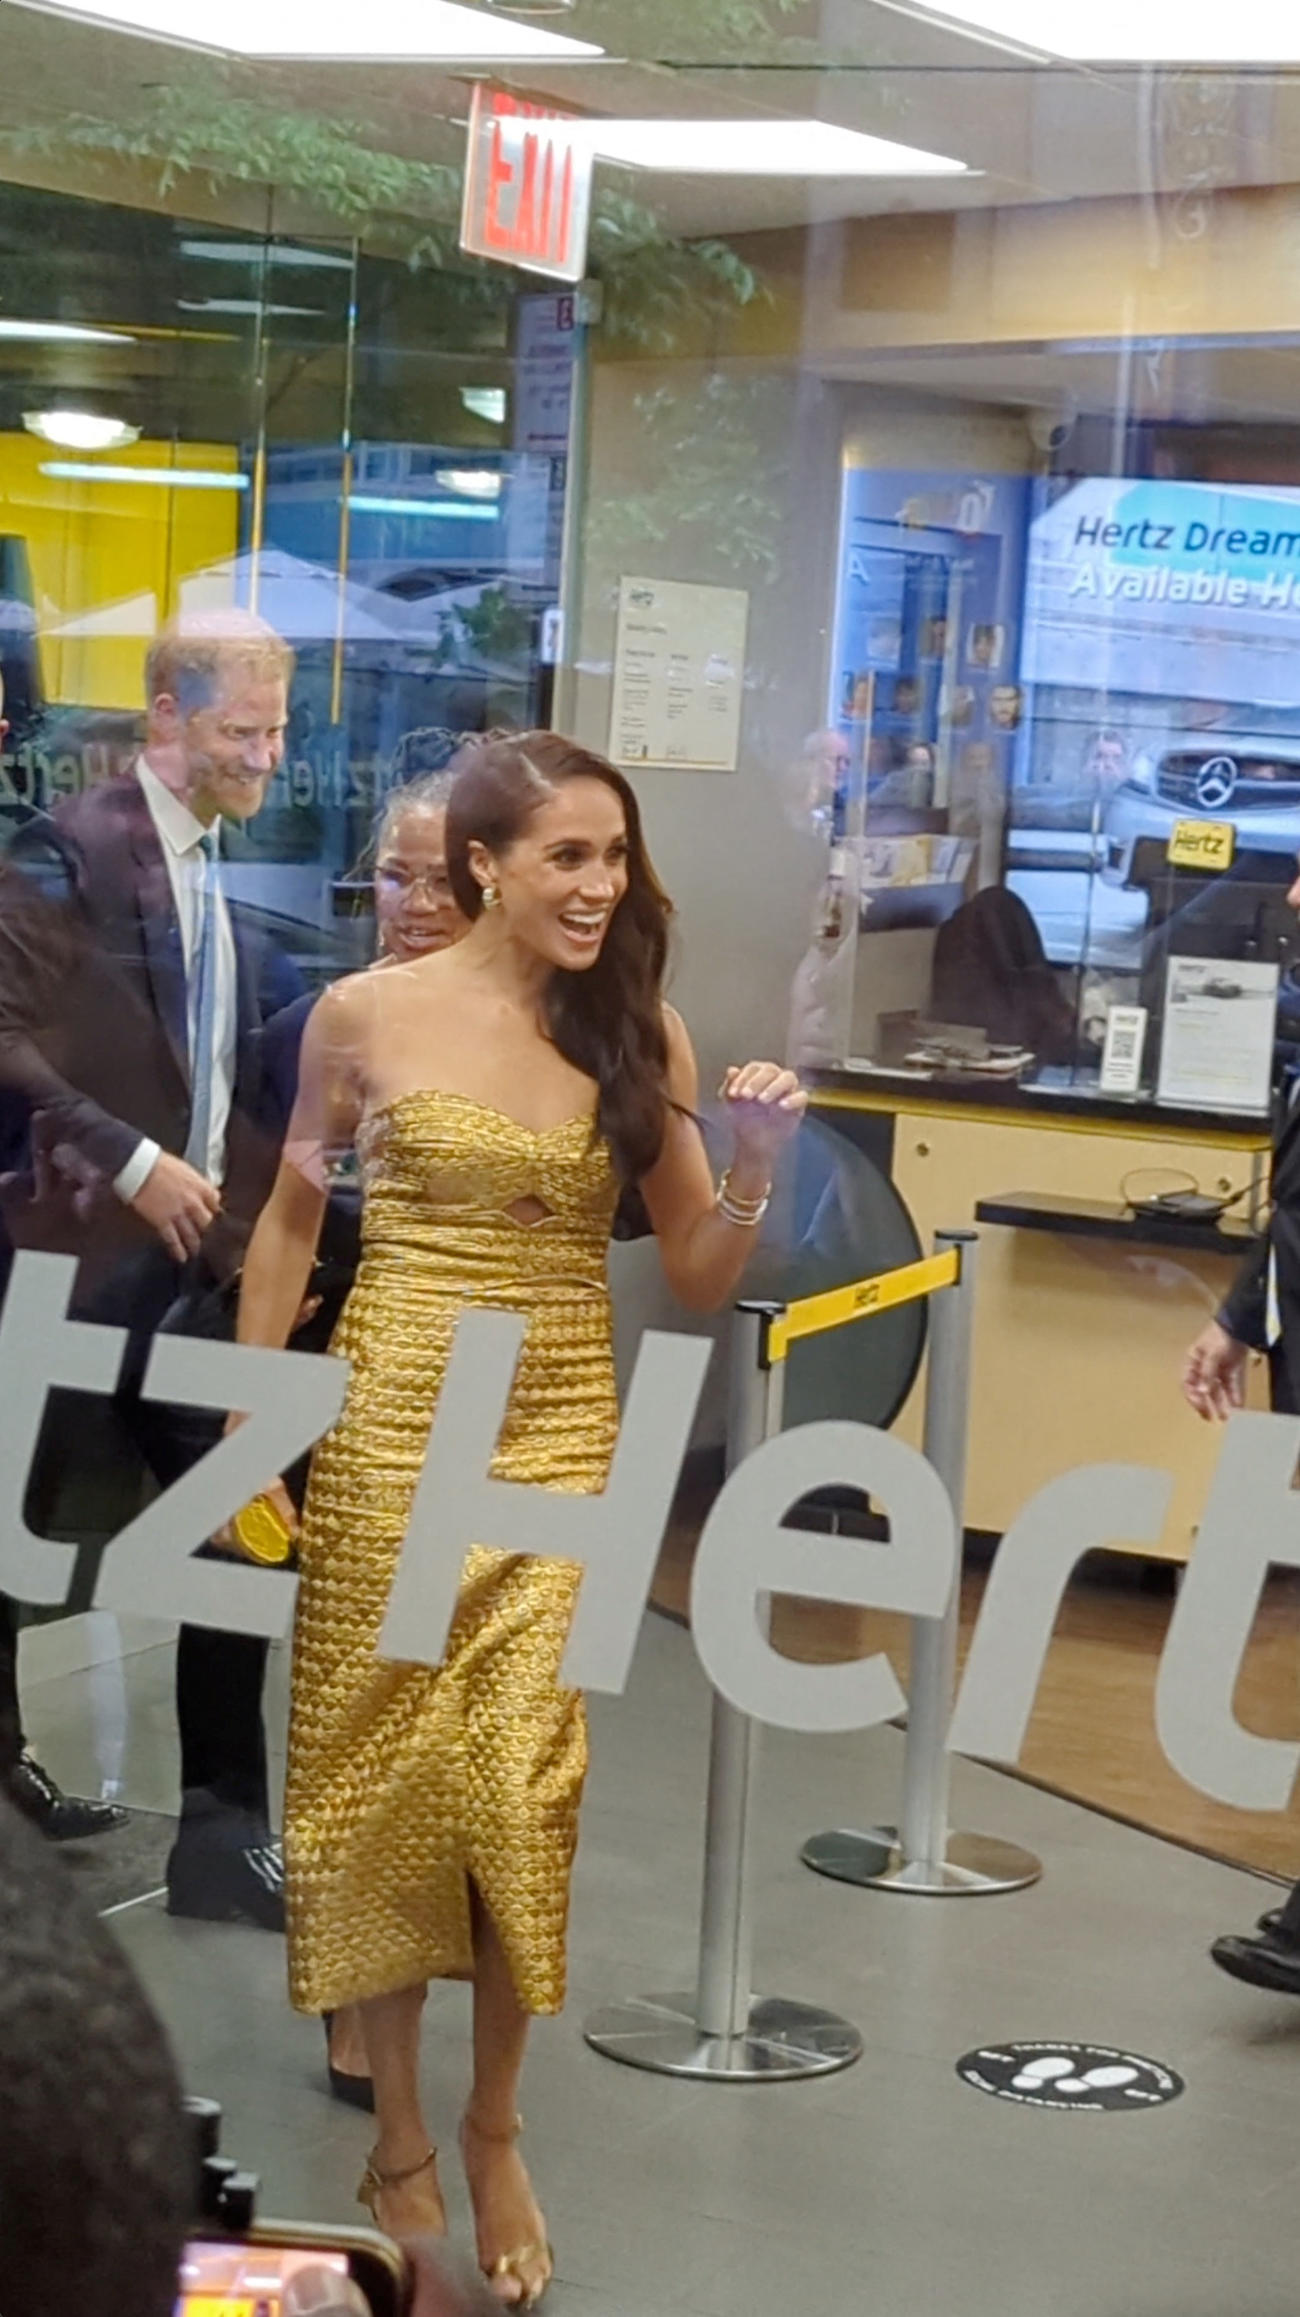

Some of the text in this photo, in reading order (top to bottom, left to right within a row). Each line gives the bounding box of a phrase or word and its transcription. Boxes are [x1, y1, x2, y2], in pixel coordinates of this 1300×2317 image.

[1074, 515, 1300, 556] Hertz Dream
[1069, 561, 1249, 607] Available
[1173, 829, 1225, 855] Hertz
[0, 1248, 1300, 1812] tz Hert
